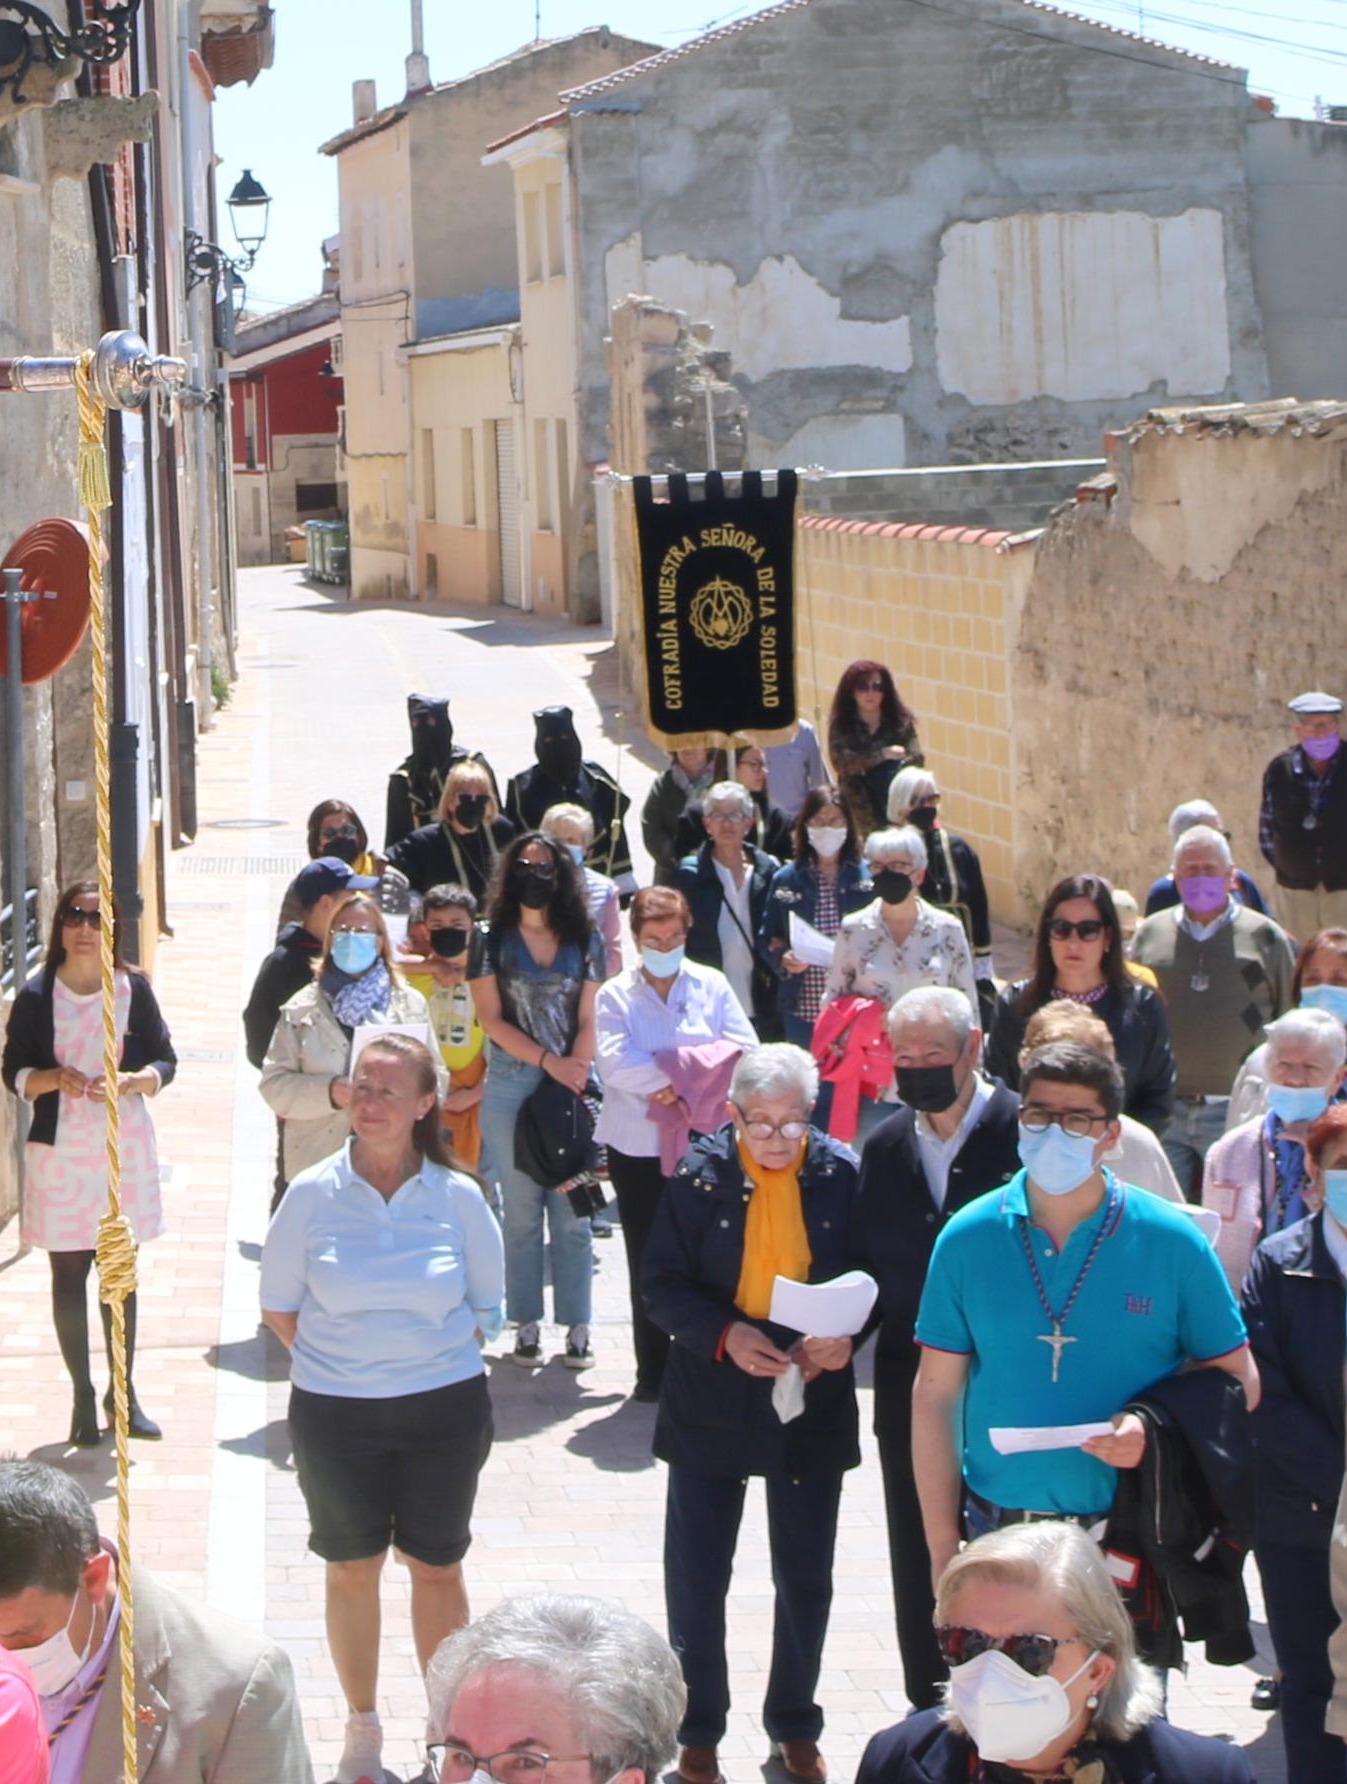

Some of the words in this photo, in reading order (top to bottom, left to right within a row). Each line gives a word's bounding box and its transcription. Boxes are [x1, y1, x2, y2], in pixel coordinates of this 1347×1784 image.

[700, 522, 765, 564] SEÑORA
[658, 535, 697, 614] NUESTRA
[756, 566, 775, 592] DE
[759, 596, 776, 619] LA
[656, 618, 682, 710] COFRADÍA
[760, 624, 780, 708] SOLEDAD
